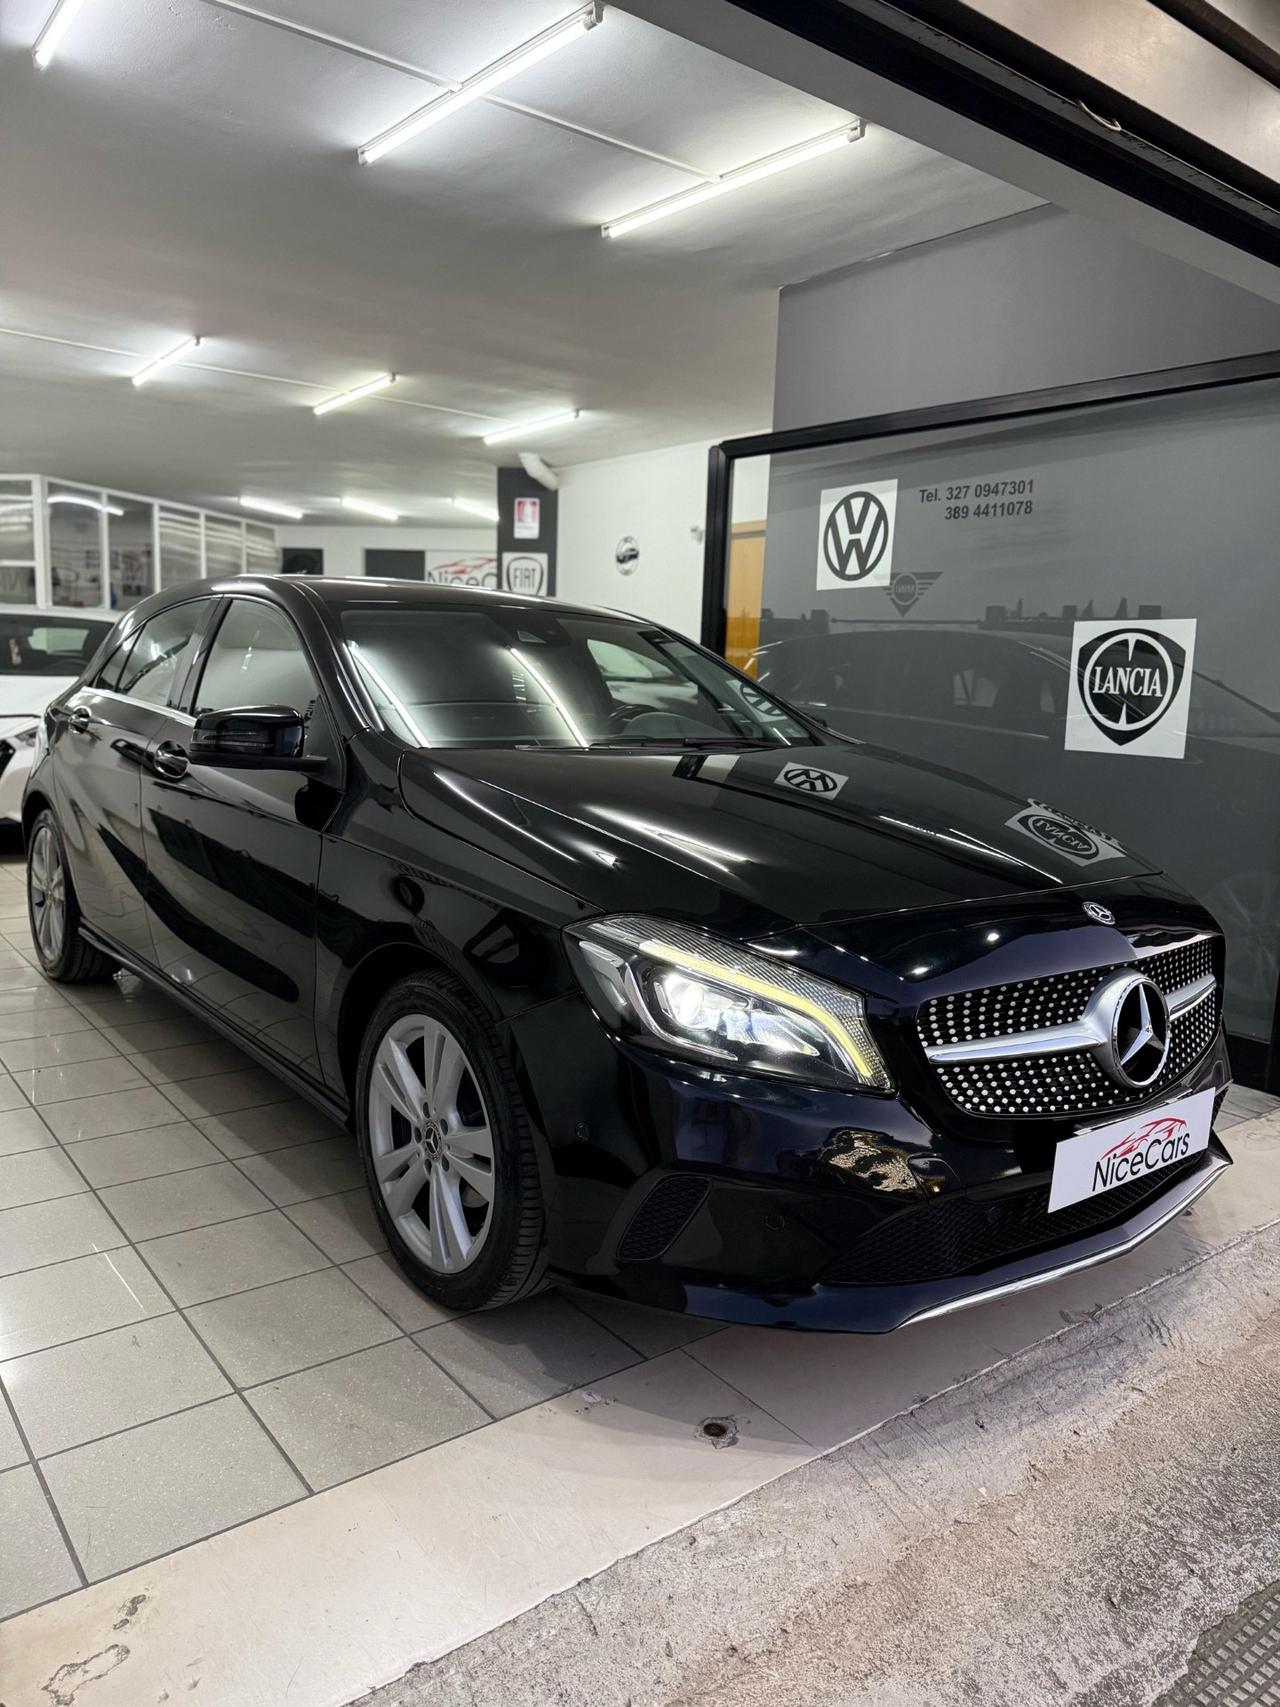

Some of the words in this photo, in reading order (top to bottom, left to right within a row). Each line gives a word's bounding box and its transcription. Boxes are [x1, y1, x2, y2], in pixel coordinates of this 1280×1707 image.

[919, 488, 941, 503] Tel.
[946, 485, 970, 501] 327
[974, 479, 1034, 498] 0947301
[945, 505, 969, 520] 389
[973, 500, 1033, 518] 4411078
[513, 567, 536, 589] FIAT
[1092, 666, 1163, 697] LANCIA
[1092, 1132, 1190, 1192] NiceCars
